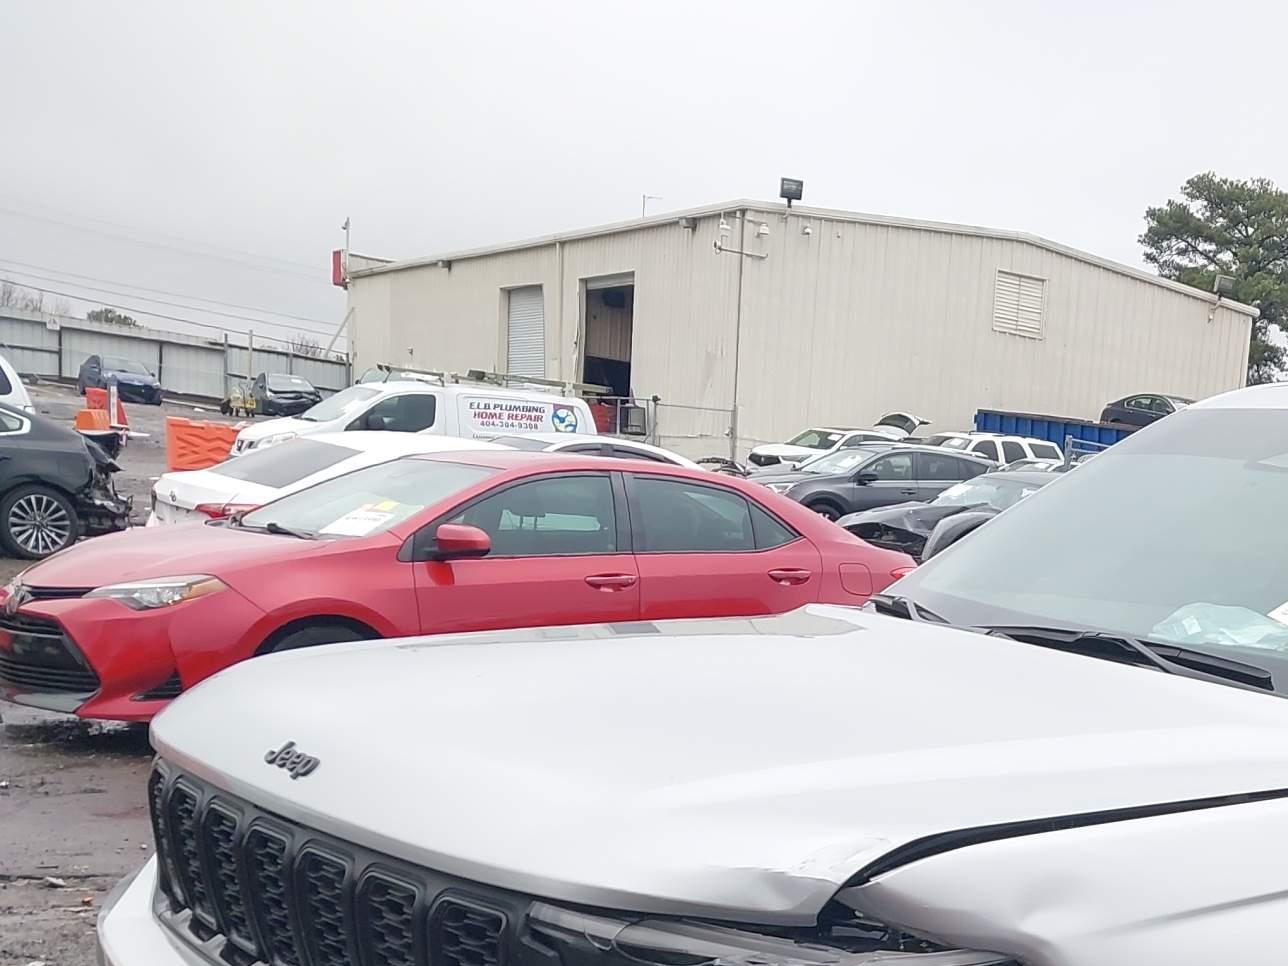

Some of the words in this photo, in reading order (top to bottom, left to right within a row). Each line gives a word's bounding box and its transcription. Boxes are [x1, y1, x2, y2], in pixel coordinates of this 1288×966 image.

[493, 404, 545, 413] PLUMBING
[473, 411, 504, 420] HOME
[507, 413, 544, 423] REPAIR
[264, 741, 321, 780] Jeep
